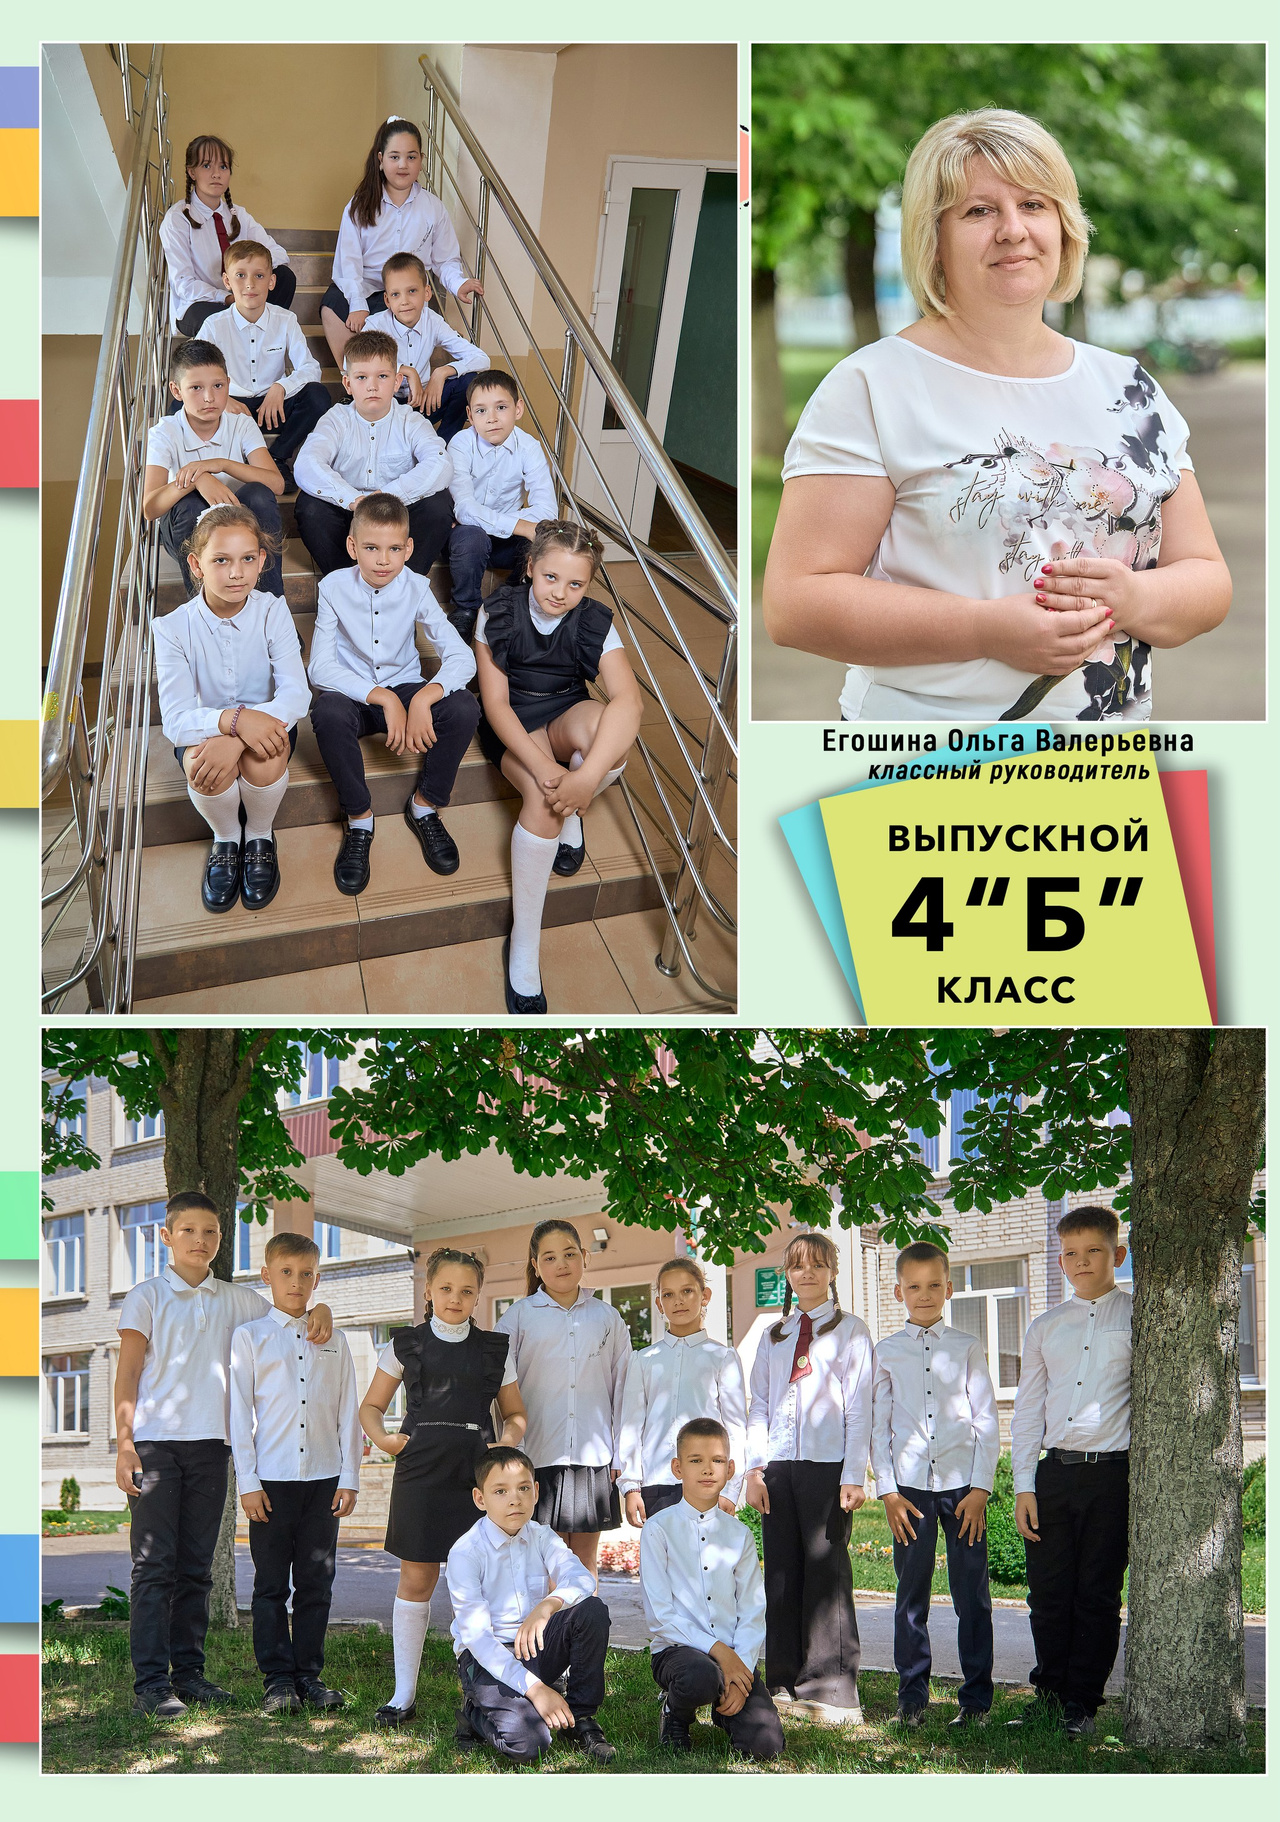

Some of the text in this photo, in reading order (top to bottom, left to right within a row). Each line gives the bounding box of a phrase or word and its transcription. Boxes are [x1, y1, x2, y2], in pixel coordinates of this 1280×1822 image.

[950, 471, 1004, 529] stay
[1018, 476, 1065, 512] with
[999, 532, 1045, 582] stay
